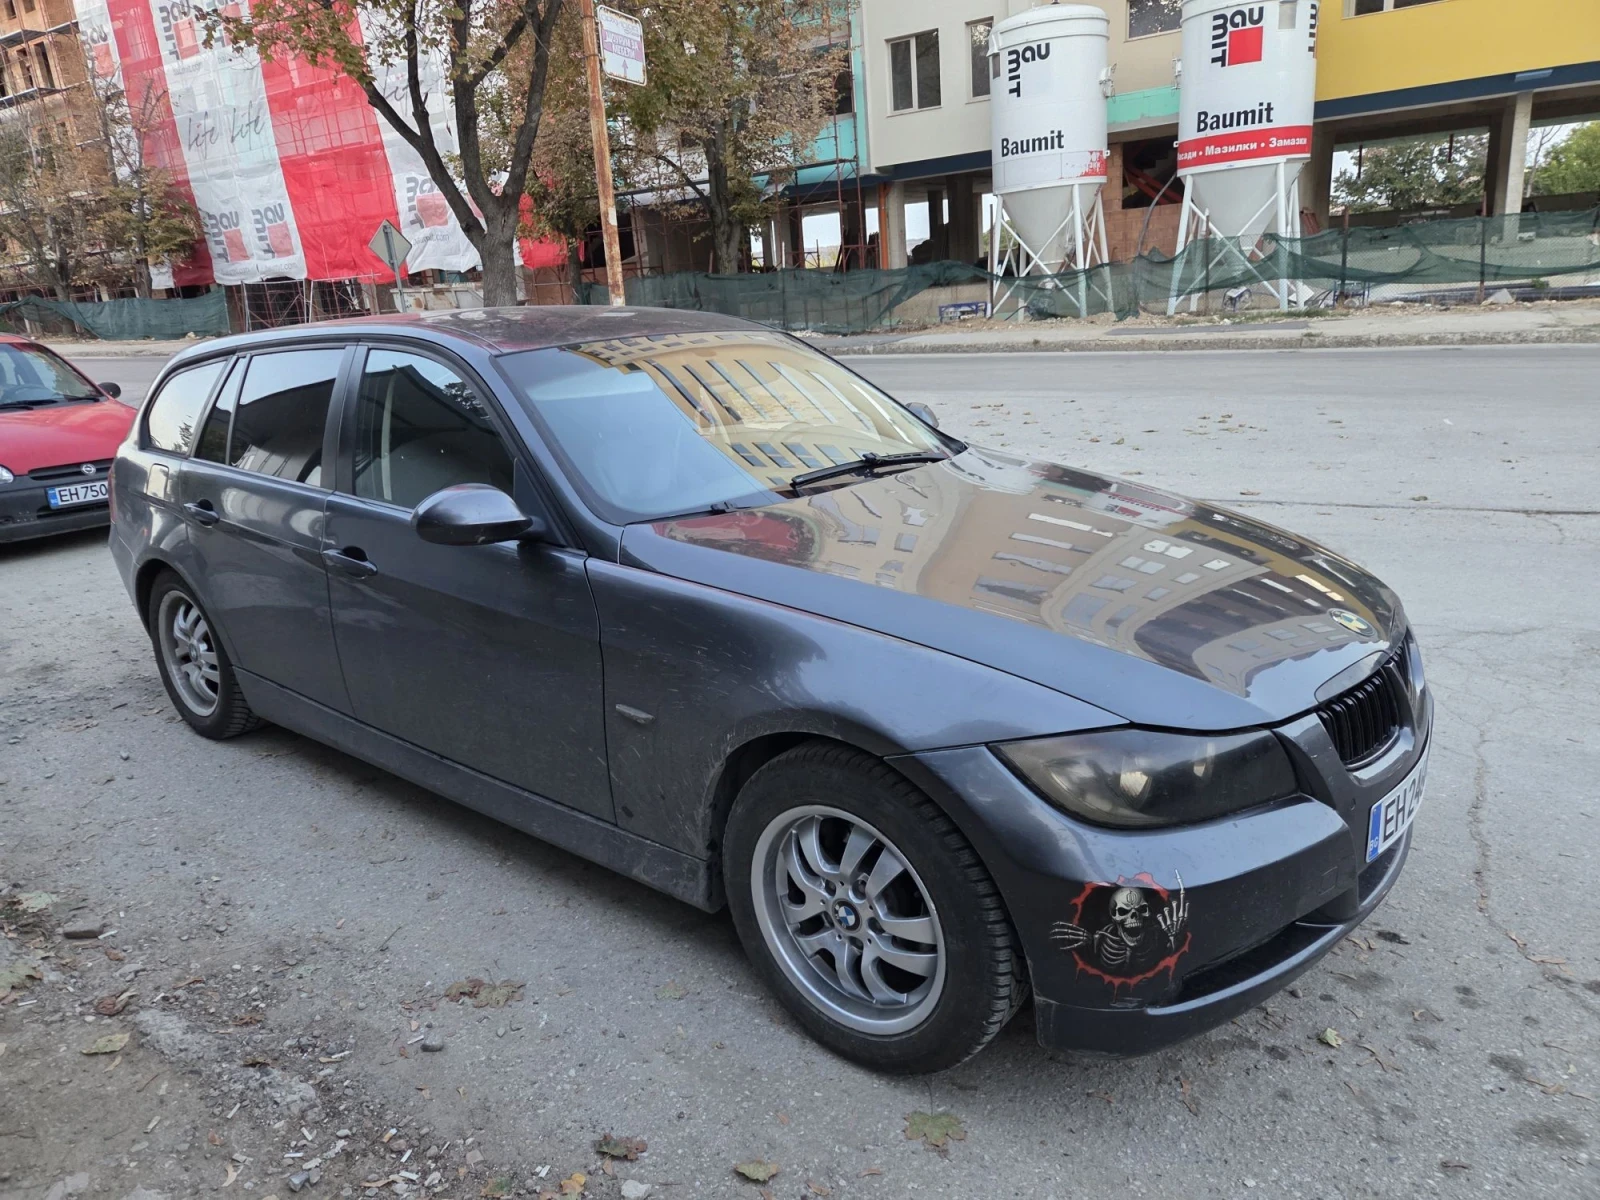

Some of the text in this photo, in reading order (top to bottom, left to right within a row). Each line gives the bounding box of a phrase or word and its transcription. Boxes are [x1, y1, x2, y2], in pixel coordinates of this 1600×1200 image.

[1197, 102, 1274, 133] Baumit
[1001, 130, 1064, 157] Baumit
[1205, 143, 1258, 156] Мазилки
